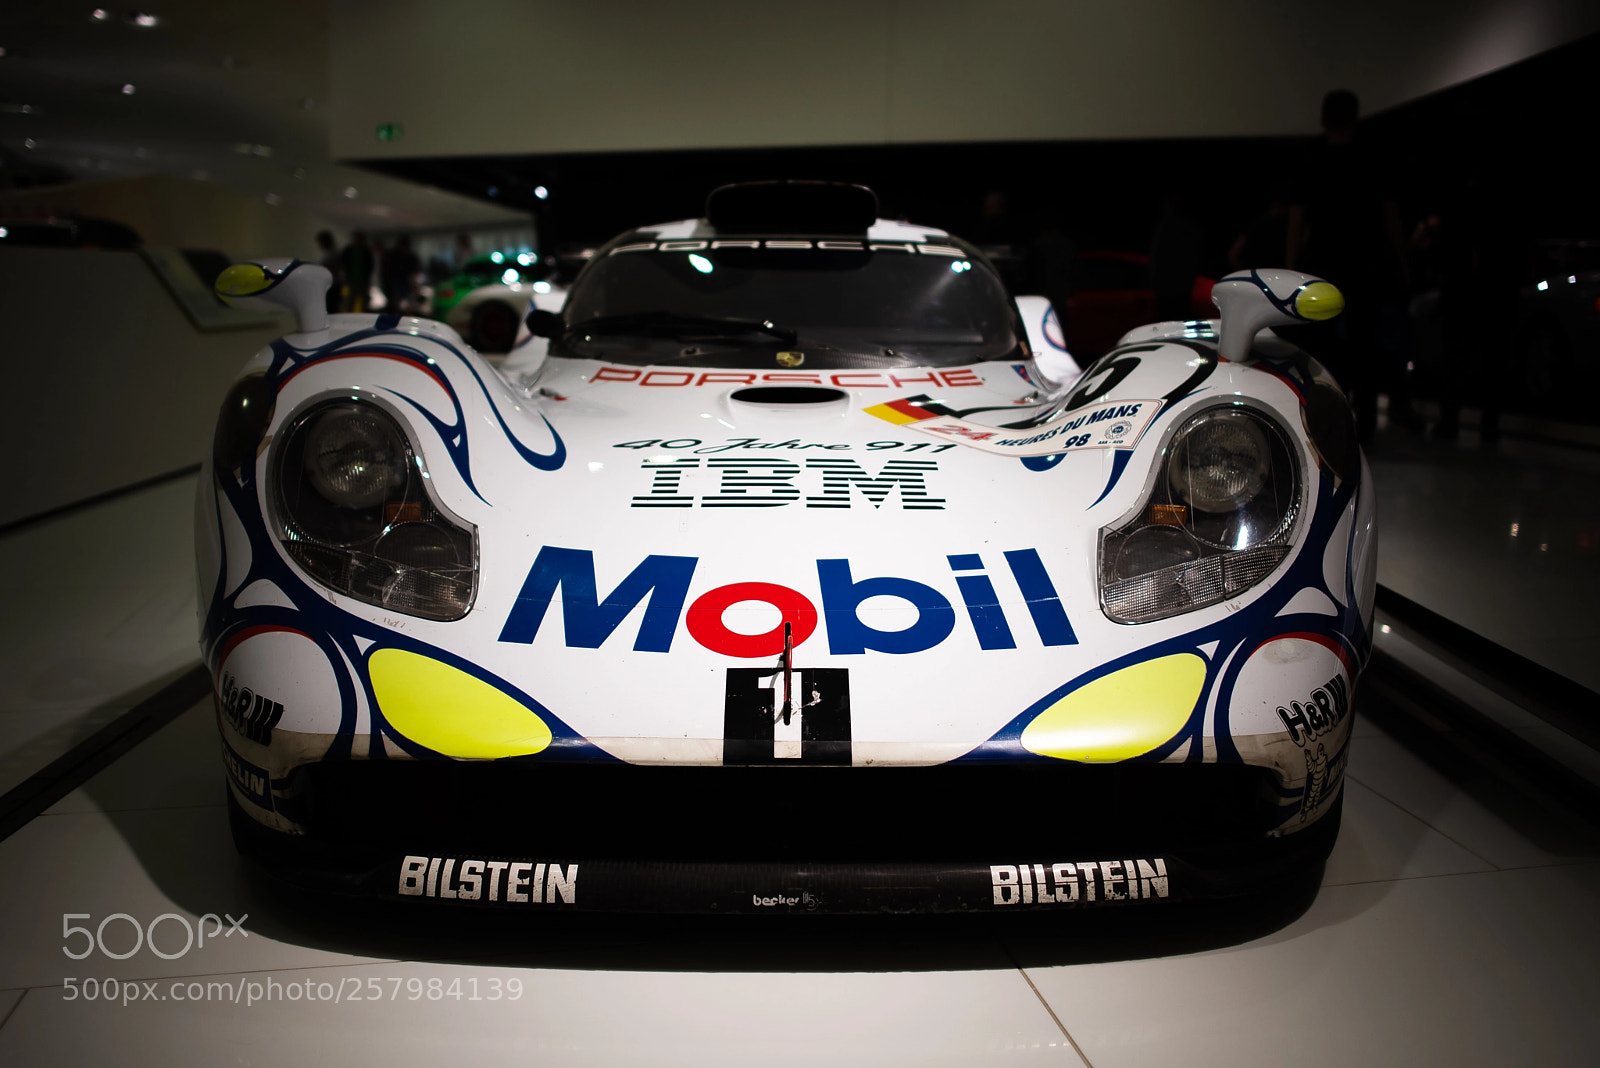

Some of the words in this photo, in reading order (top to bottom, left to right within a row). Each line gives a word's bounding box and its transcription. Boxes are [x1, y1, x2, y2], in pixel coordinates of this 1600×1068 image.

[609, 240, 967, 257] PORSCHE
[590, 368, 984, 388] PORSCHE
[612, 438, 702, 450] 40
[693, 438, 852, 454] Jahre
[865, 440, 958, 453] 911
[995, 426, 1062, 446] HEURES
[1060, 414, 1088, 435] DU
[1085, 404, 1143, 426] MANS
[1063, 433, 1092, 449] 98
[631, 458, 946, 510] IBM
[497, 545, 1079, 659] Mobil
[758, 671, 802, 758] 1
[1276, 687, 1339, 747] H&R
[398, 855, 578, 905] BILSTEIN
[989, 858, 1169, 906] BILSTEIN
